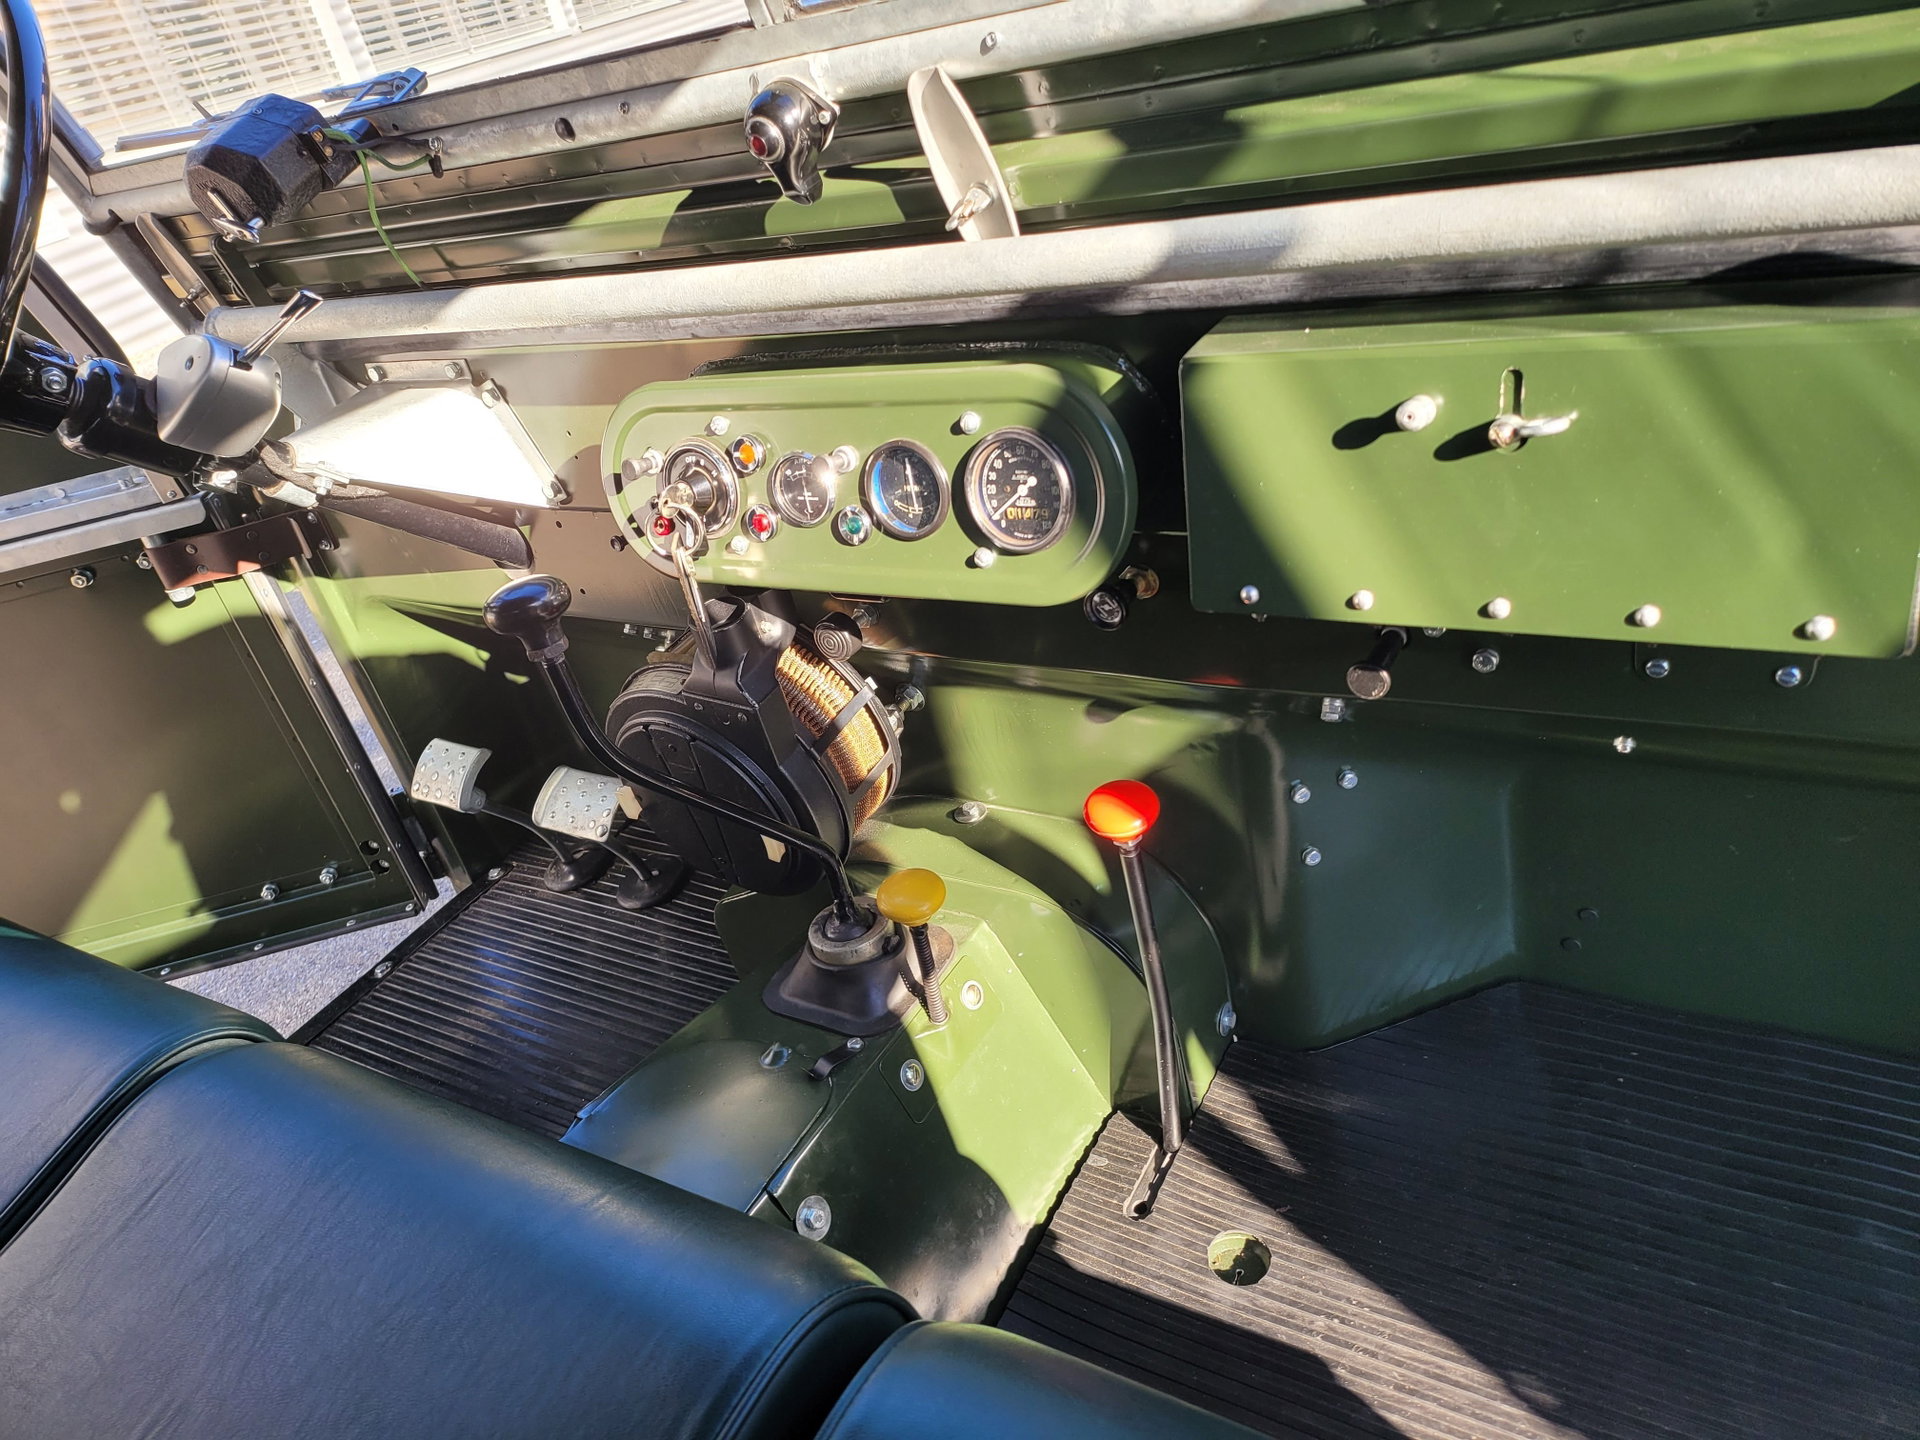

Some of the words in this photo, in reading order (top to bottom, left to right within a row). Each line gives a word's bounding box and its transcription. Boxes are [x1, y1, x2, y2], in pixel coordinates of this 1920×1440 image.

[993, 459, 1003, 469] 40
[988, 472, 997, 480] 30
[987, 484, 996, 494] 20
